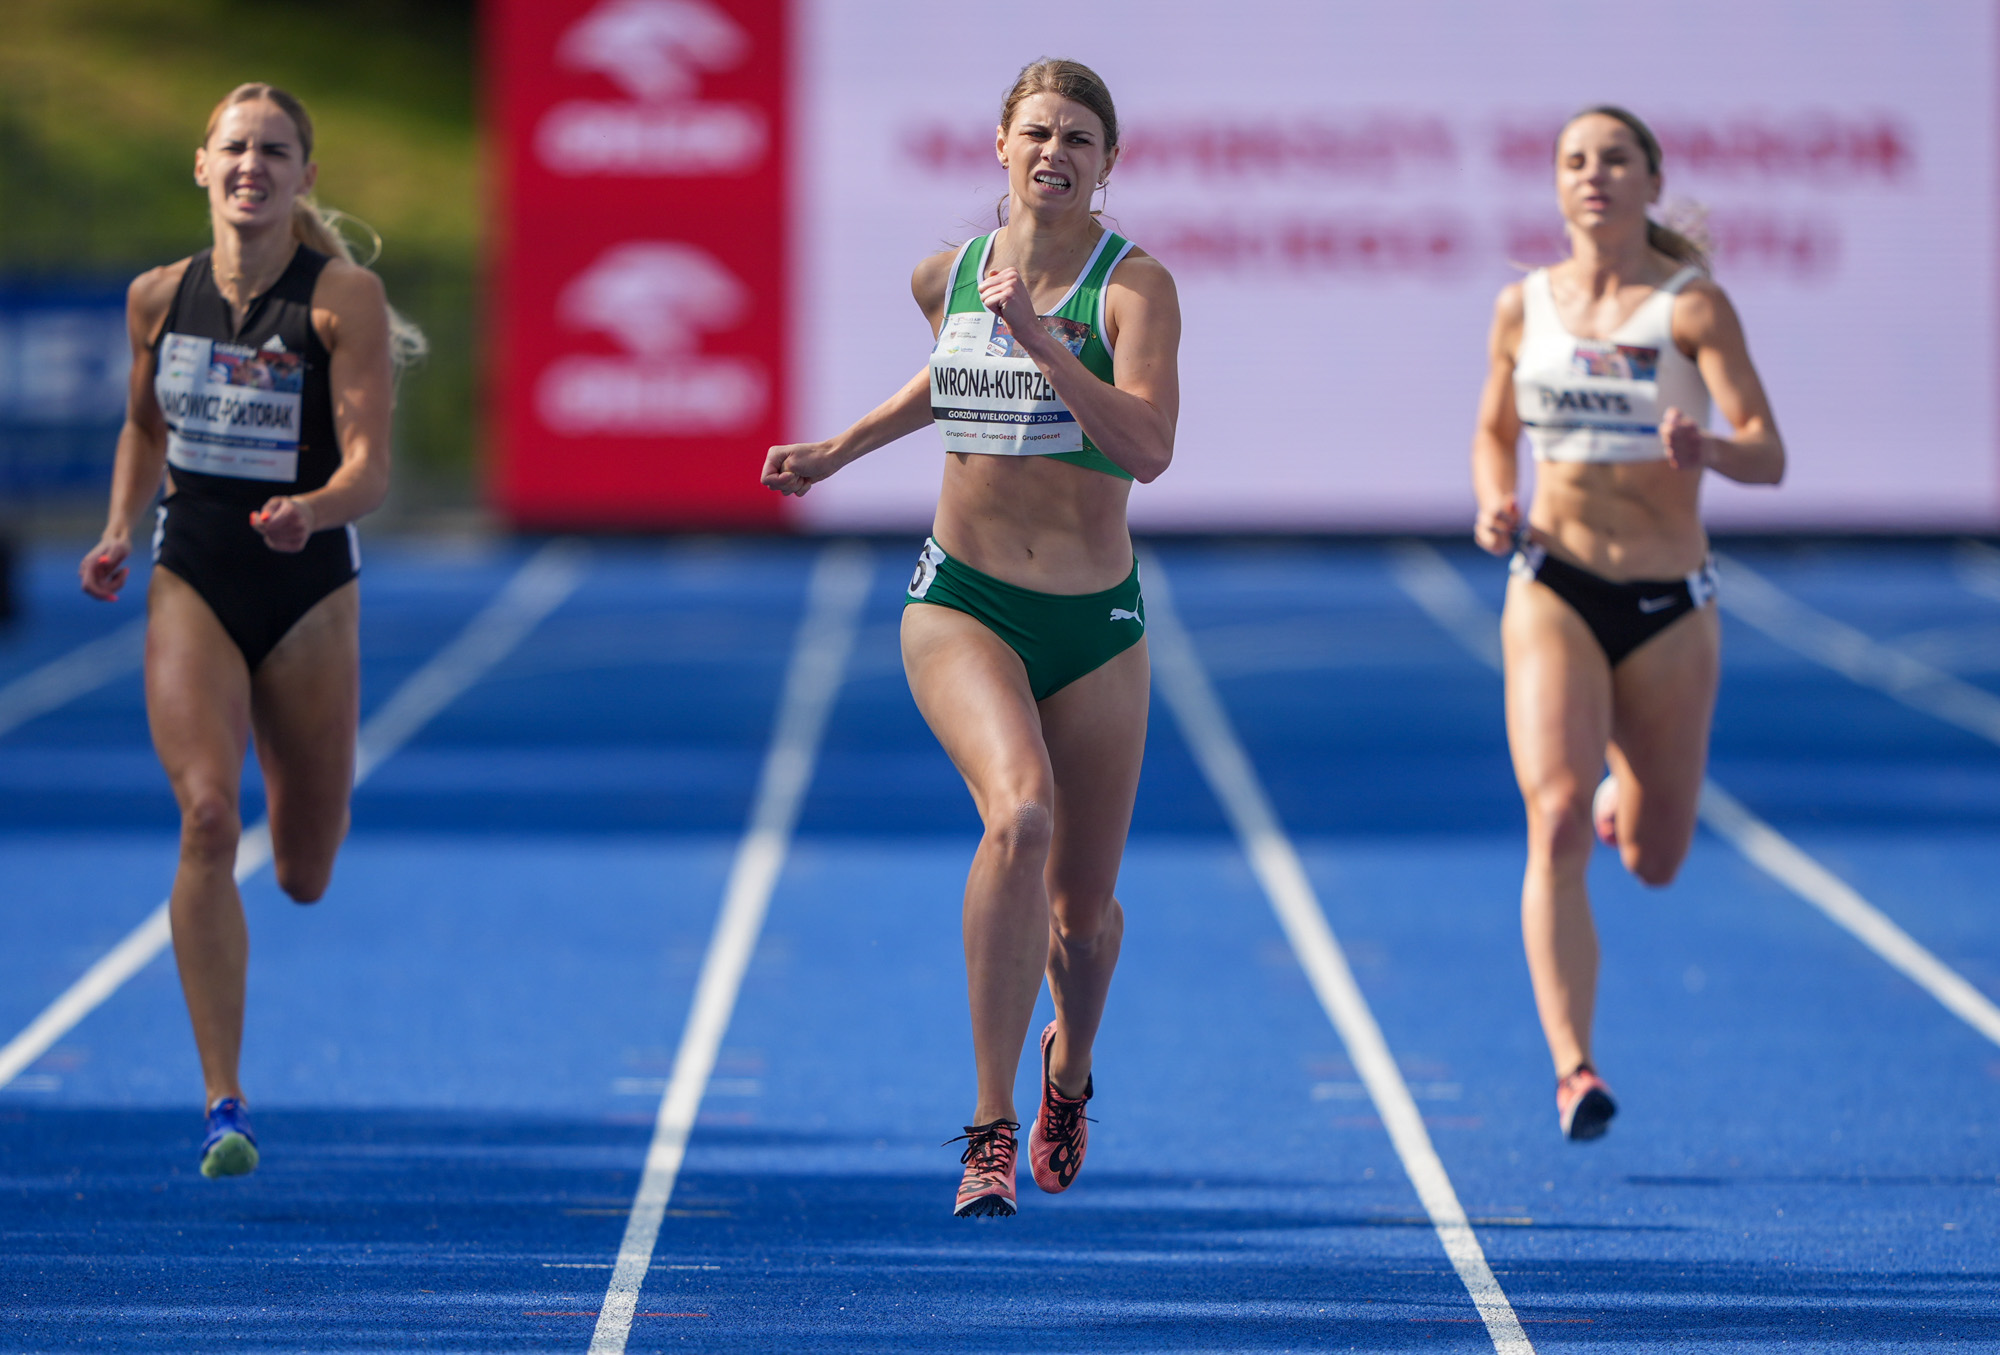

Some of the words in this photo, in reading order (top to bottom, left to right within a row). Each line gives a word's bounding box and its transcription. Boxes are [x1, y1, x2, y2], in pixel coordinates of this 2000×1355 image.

[948, 410, 979, 421] GORZÓW
[980, 412, 1036, 423] WIELKOPOLSKI
[1036, 414, 1059, 422] 2024
[945, 430, 978, 439] GrupoGezet
[981, 432, 1018, 441] GrupoGezet
[1022, 432, 1061, 441] GrupoGezet
